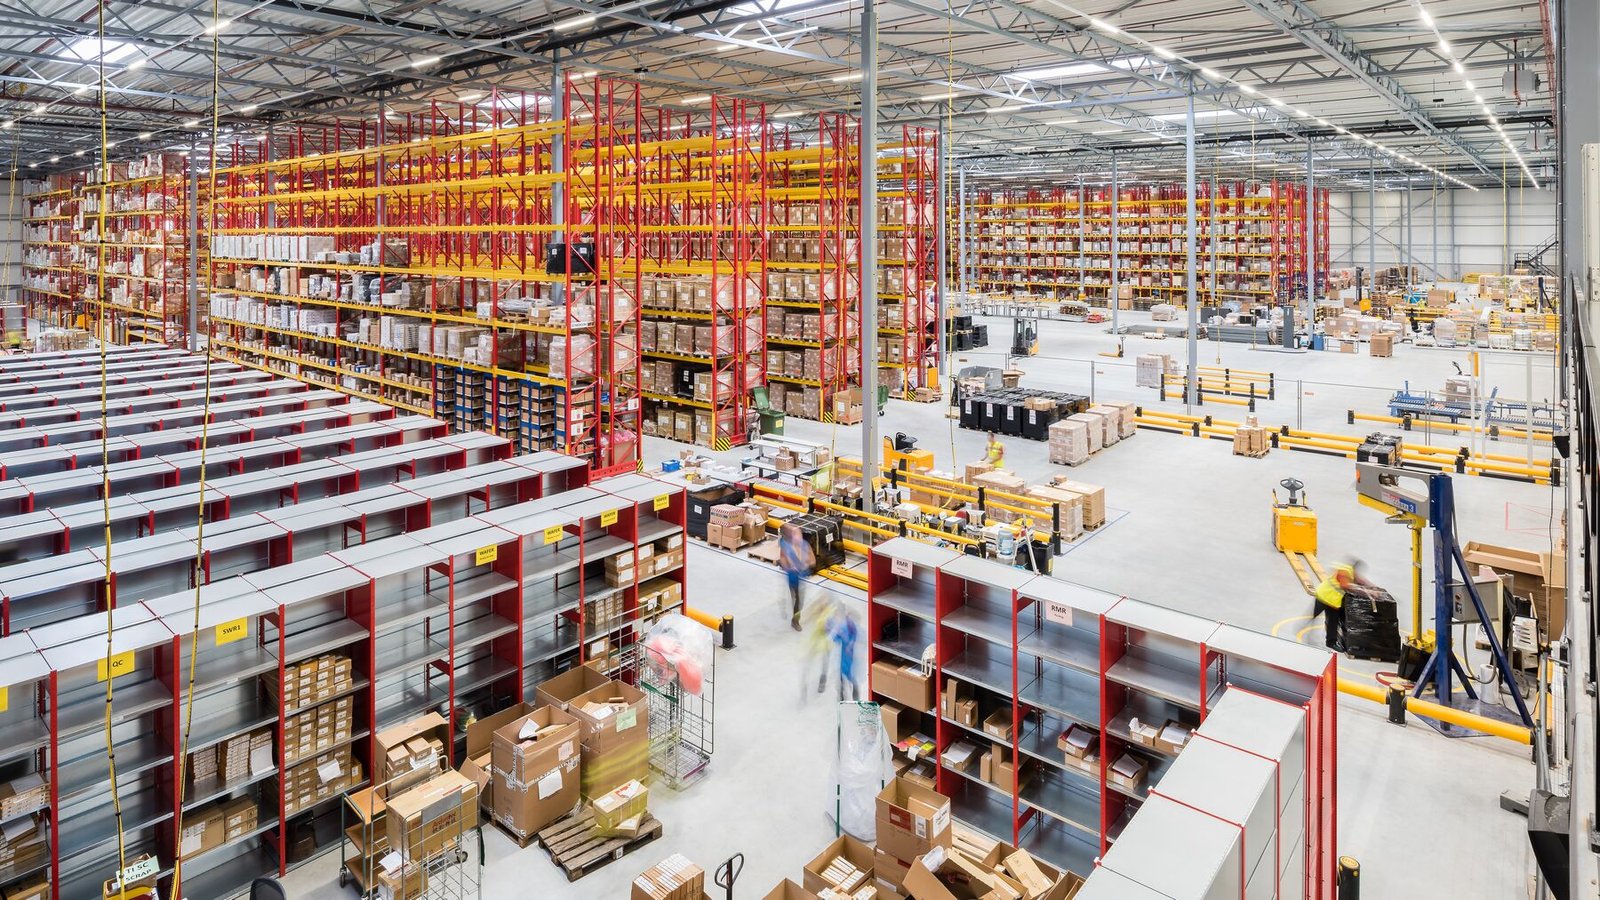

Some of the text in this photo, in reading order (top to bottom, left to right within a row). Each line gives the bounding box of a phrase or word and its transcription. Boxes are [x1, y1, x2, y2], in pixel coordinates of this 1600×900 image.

[479, 547, 495, 556] WAFER
[896, 559, 909, 568] RMR
[1051, 604, 1067, 614] RMR
[112, 659, 124, 668] QC
[137, 861, 149, 871] SC
[125, 868, 152, 881] SCRAP
